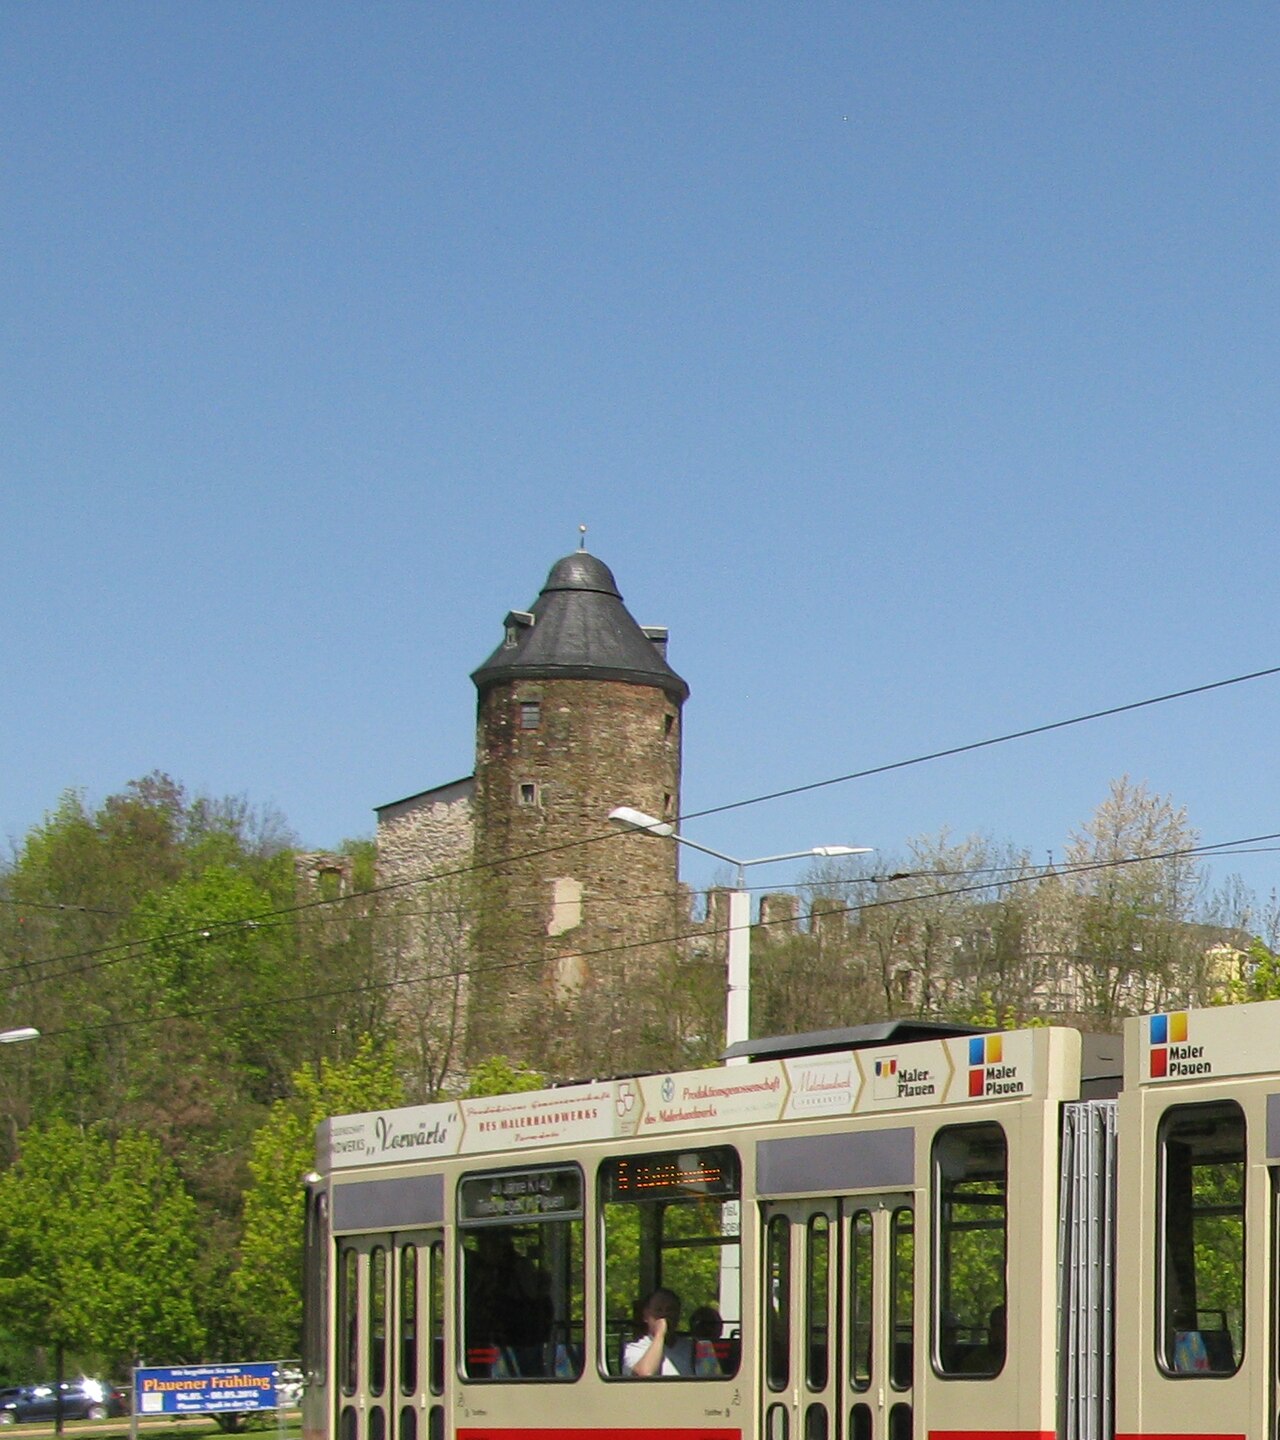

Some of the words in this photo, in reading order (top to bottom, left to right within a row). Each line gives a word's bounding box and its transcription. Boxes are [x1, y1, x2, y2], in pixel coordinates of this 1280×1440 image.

[1168, 1045, 1205, 1061] Maler
[898, 1069, 930, 1084] Maler
[986, 1066, 1017, 1080] Maler
[1168, 1061, 1212, 1077] Plauen
[897, 1084, 935, 1098] Plauen
[986, 1081, 1024, 1096] Plauen
[479, 1121, 498, 1133] DES
[500, 1108, 598, 1130] MALERHANDWERKS
[143, 1379, 208, 1391] Plauener
[211, 1375, 271, 1390] Frühling
